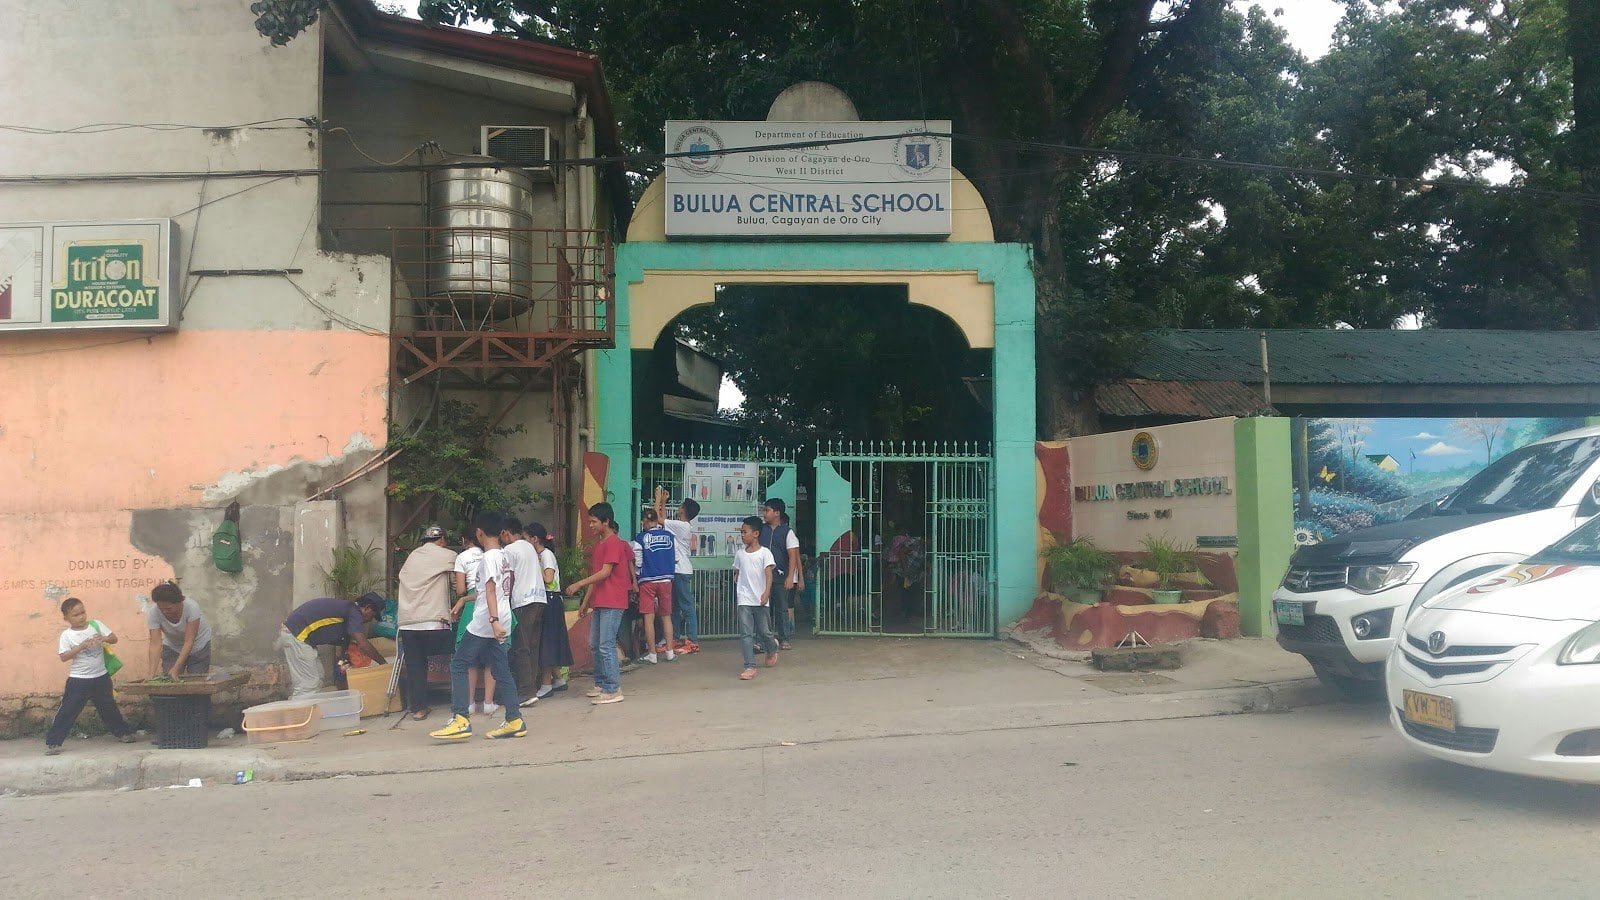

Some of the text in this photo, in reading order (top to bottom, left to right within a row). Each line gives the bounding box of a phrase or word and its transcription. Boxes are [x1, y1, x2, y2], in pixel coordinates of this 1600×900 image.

[754, 130, 863, 140] Department of Education
[748, 154, 872, 165] Division of Cagayan de Oro
[776, 167, 844, 175] West II District
[673, 192, 945, 213] BULUA CENTRAL SCHOOL
[737, 215, 882, 227] Bulua, Cagayan de Oro City
[71, 255, 140, 281] triton
[55, 290, 155, 308] DURACOAT
[69, 558, 154, 571] DONATED BY:
